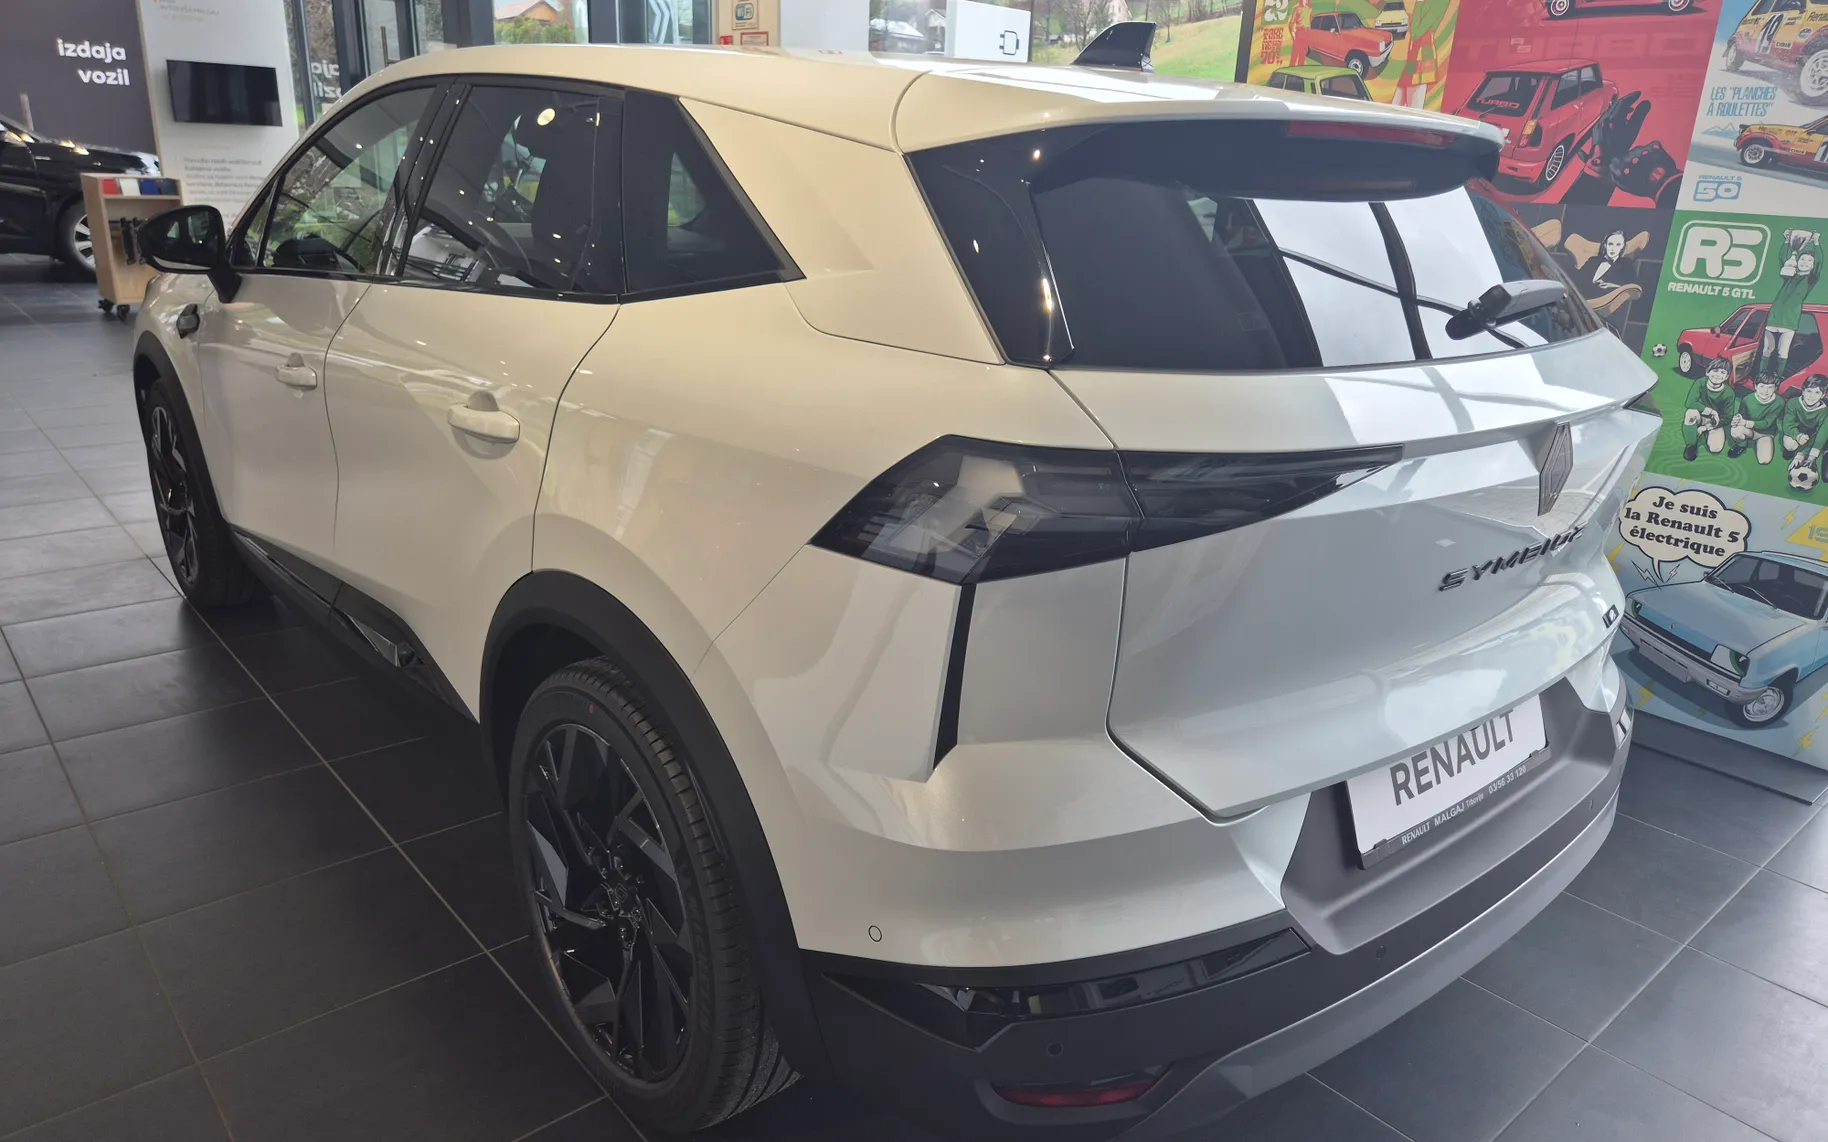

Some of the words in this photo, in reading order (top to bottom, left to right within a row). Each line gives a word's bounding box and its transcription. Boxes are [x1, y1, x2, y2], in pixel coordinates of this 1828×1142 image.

[57, 38, 126, 63] izdaja
[77, 68, 131, 86] vozil
[1710, 86, 1727, 101] LES
[1729, 86, 1779, 101] "PLANCHES
[1716, 101, 1774, 117] ROULETTES"
[1694, 182, 1740, 201] 50
[1667, 282, 1722, 296] RENAULT
[1722, 287, 1730, 297] 5
[1731, 288, 1756, 299] GTL
[1652, 496, 1675, 510] Je
[1680, 504, 1718, 520] suis
[1624, 507, 1641, 521] la
[1645, 511, 1723, 539] Renault
[1727, 530, 1741, 543] 5
[1629, 525, 1726, 557] électrique
[1390, 708, 1514, 807] RENAULT
[1401, 821, 1431, 846] RENAULT
[1434, 802, 1465, 827] MALGAJ
[1488, 779, 1506, 795] 03/56
[1506, 772, 1514, 784] 33
[1515, 764, 1527, 779] 120
